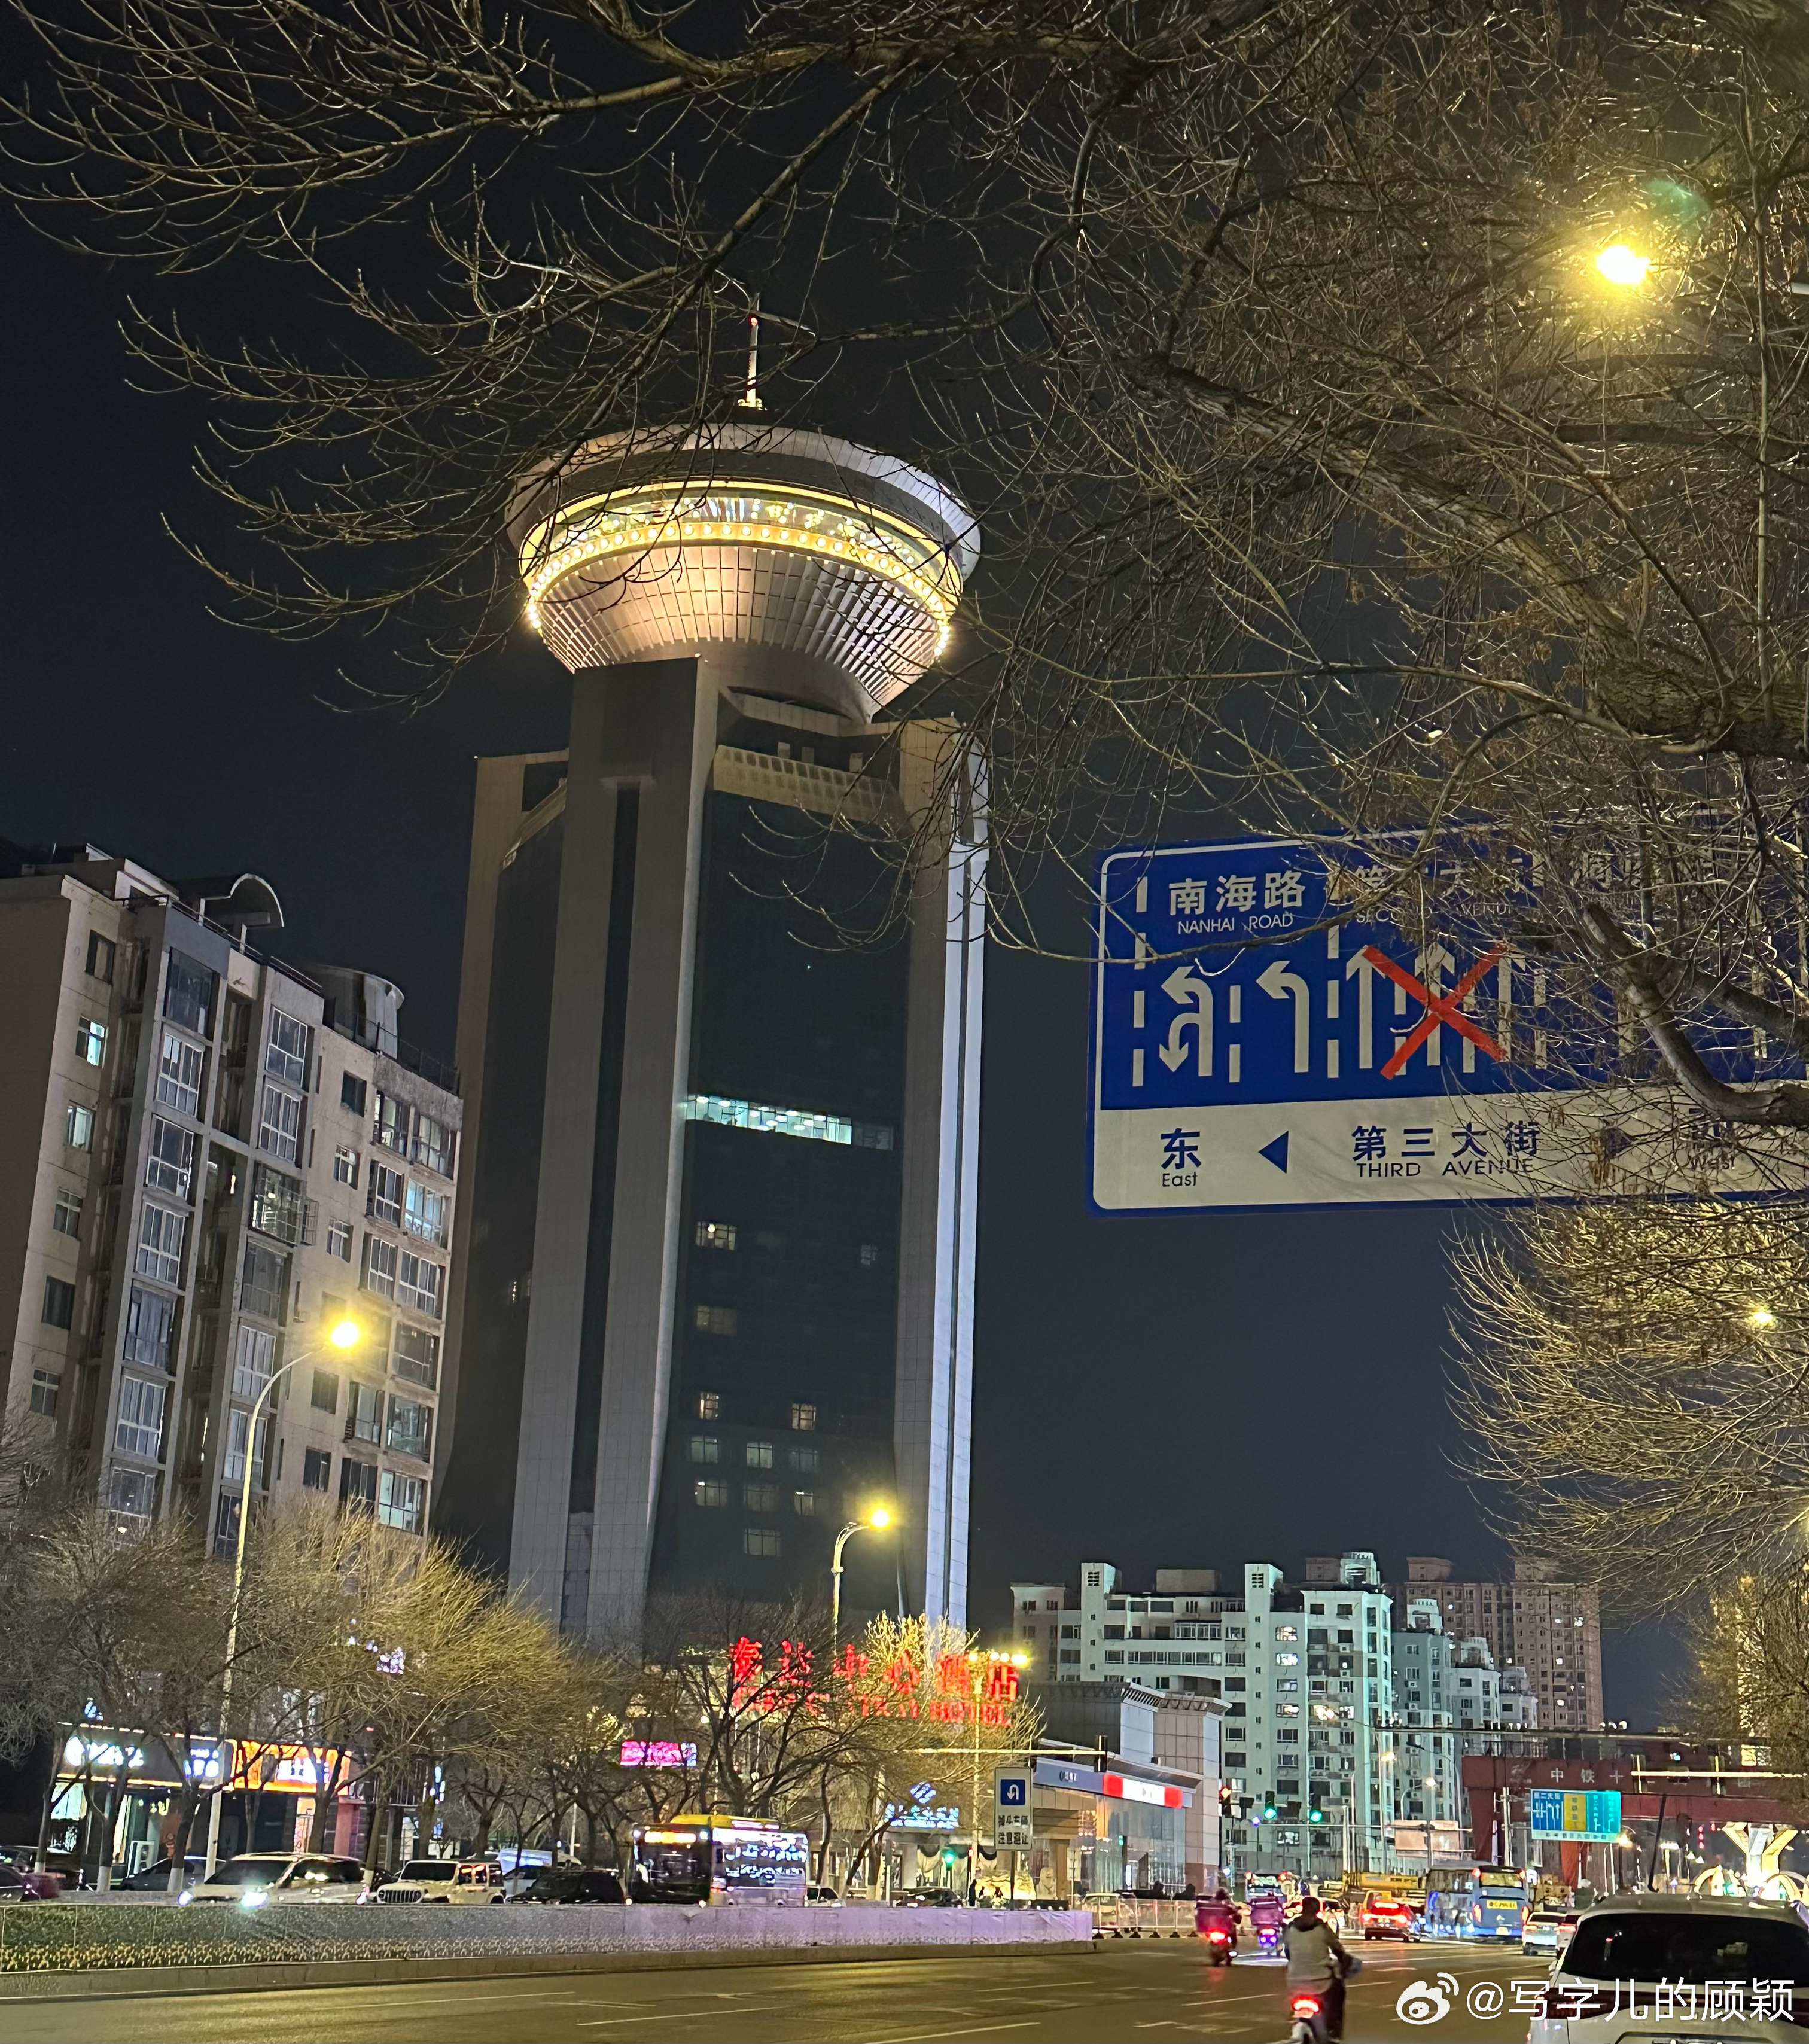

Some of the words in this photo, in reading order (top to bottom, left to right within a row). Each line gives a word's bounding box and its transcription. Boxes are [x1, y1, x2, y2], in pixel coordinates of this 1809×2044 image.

[1168, 870, 1306, 916] 南海路
[1178, 916, 1235, 934] NANHAI
[1248, 914, 1294, 929] ROAD
[1161, 1128, 1202, 1170] 东
[1351, 1120, 1541, 1162] 第三大街
[1162, 1172, 1198, 1187] East
[1356, 1162, 1421, 1177] THIRD
[1442, 1159, 1533, 1177] AVENUE
[930, 1700, 1012, 1728] HOTEL
